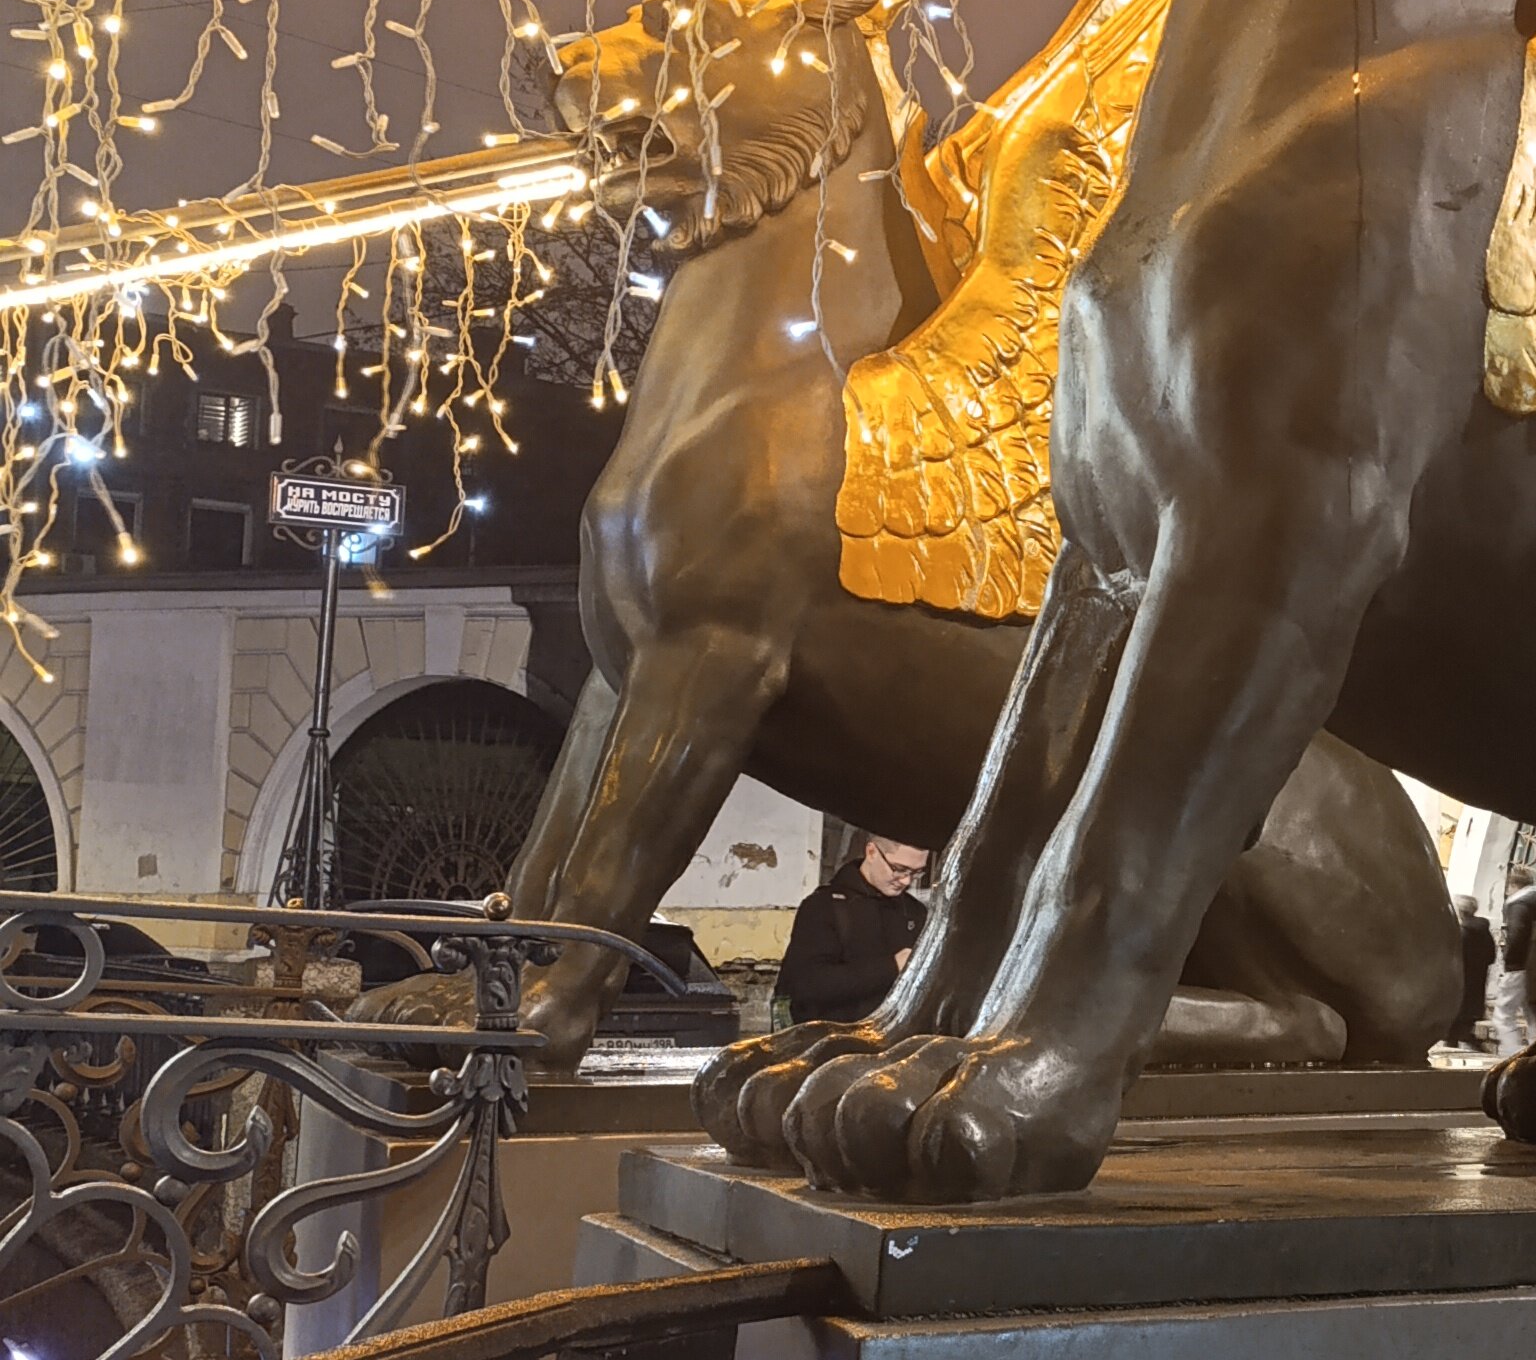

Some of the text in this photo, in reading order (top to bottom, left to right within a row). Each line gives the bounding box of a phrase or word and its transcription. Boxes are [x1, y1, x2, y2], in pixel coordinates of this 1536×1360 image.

[288, 486, 391, 507] НА МОСТУ
[286, 497, 390, 521] КУРИТЬ ВОСПРЕЩАЕТСЯ
